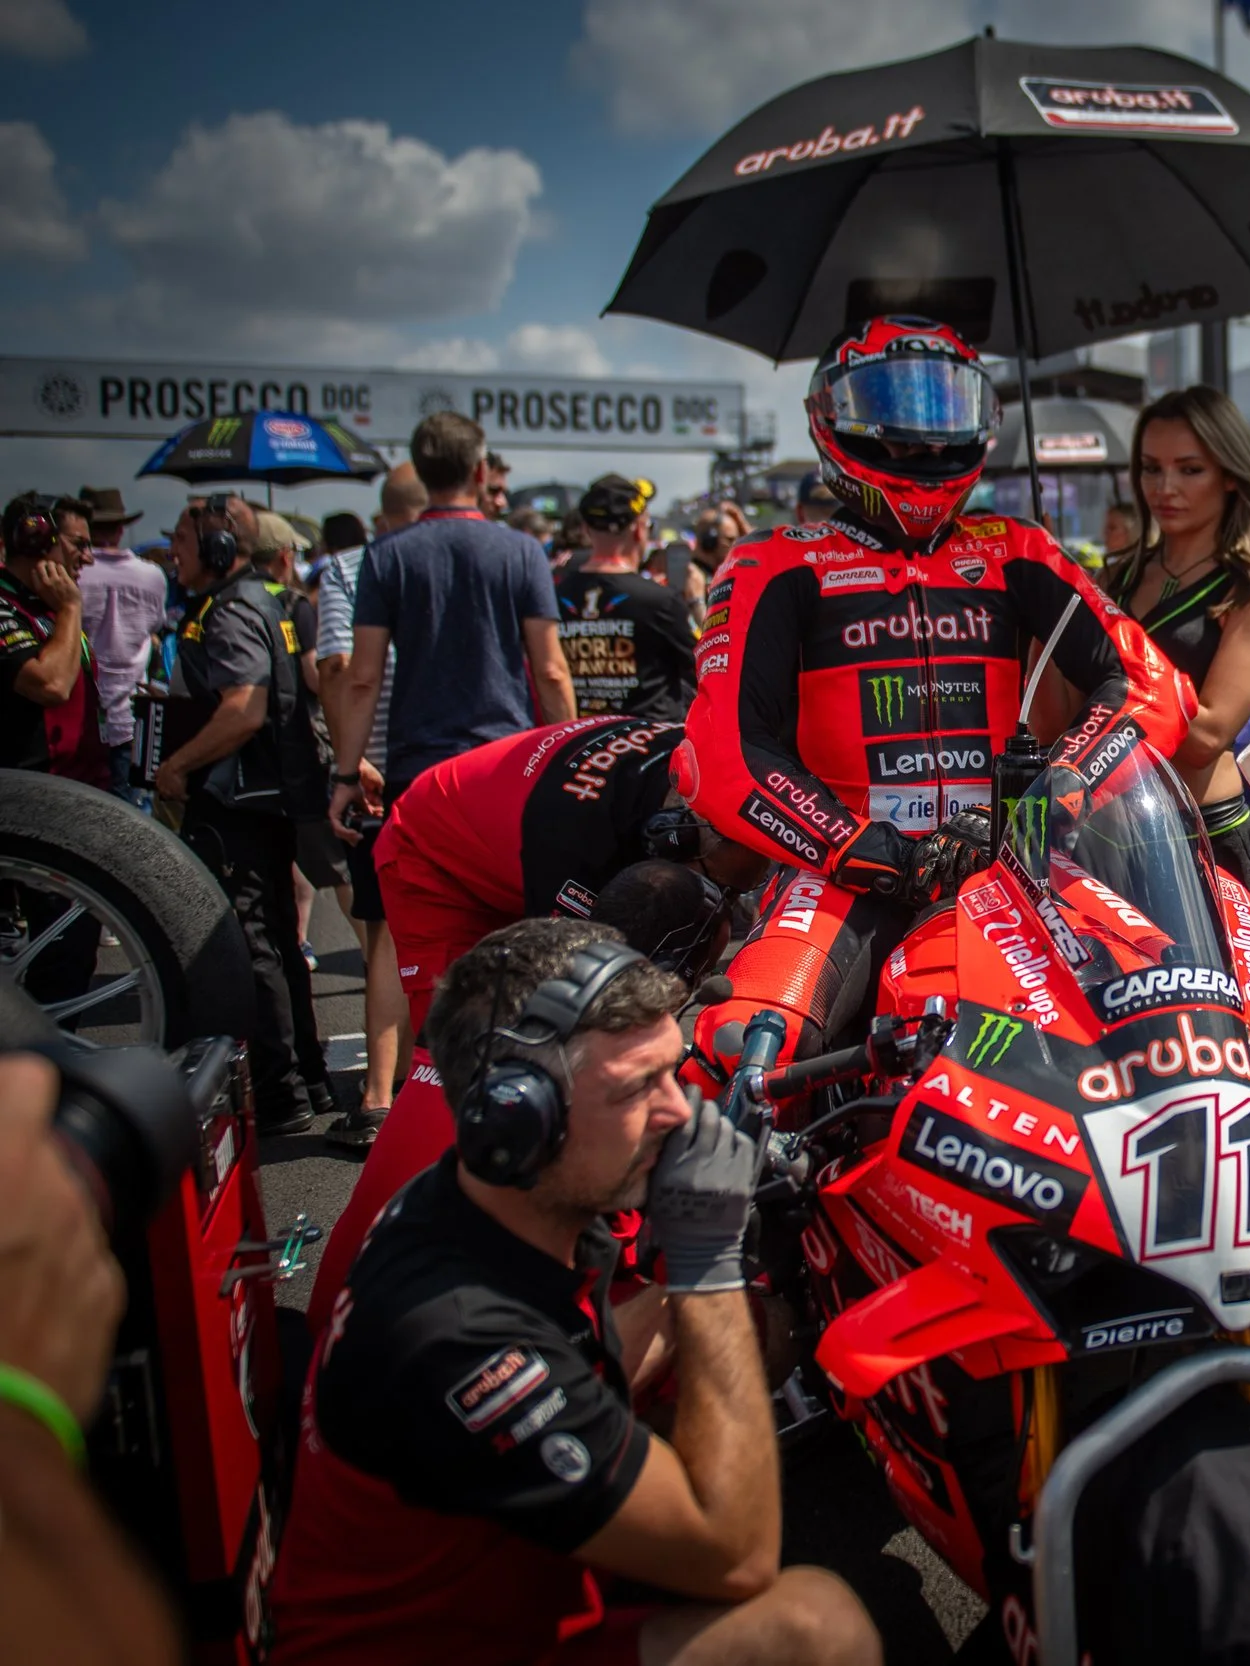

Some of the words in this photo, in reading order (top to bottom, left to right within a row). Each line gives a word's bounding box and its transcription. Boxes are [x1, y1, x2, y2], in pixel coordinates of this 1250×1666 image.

[1050, 84, 1192, 110] aruba.it
[735, 105, 925, 176] aruba.it
[100, 376, 310, 421] PROSECCO
[322, 384, 372, 411] DOC
[472, 388, 662, 435] PROSECCO
[673, 396, 718, 424] DOC
[828, 571, 880, 583] CARRERA
[843, 601, 992, 648] aruba.it
[908, 680, 981, 697] MONSTER
[879, 750, 986, 777] Lenovo
[1081, 726, 1137, 786] Lenovo
[748, 799, 819, 861] Lenovo
[767, 770, 855, 843] aruba.it
[1036, 896, 1088, 964] WRS
[996, 933, 1050, 989] riello
[1026, 988, 1060, 1030] ups
[1103, 967, 1243, 1009] CARRERA
[1107, 993, 1172, 1020] EYEWEAR
[1182, 991, 1219, 1001] SINCE
[924, 1073, 1081, 1156] ALTEN
[914, 1116, 1064, 1210] Lenovo
[1085, 1317, 1185, 1350] Dierre
